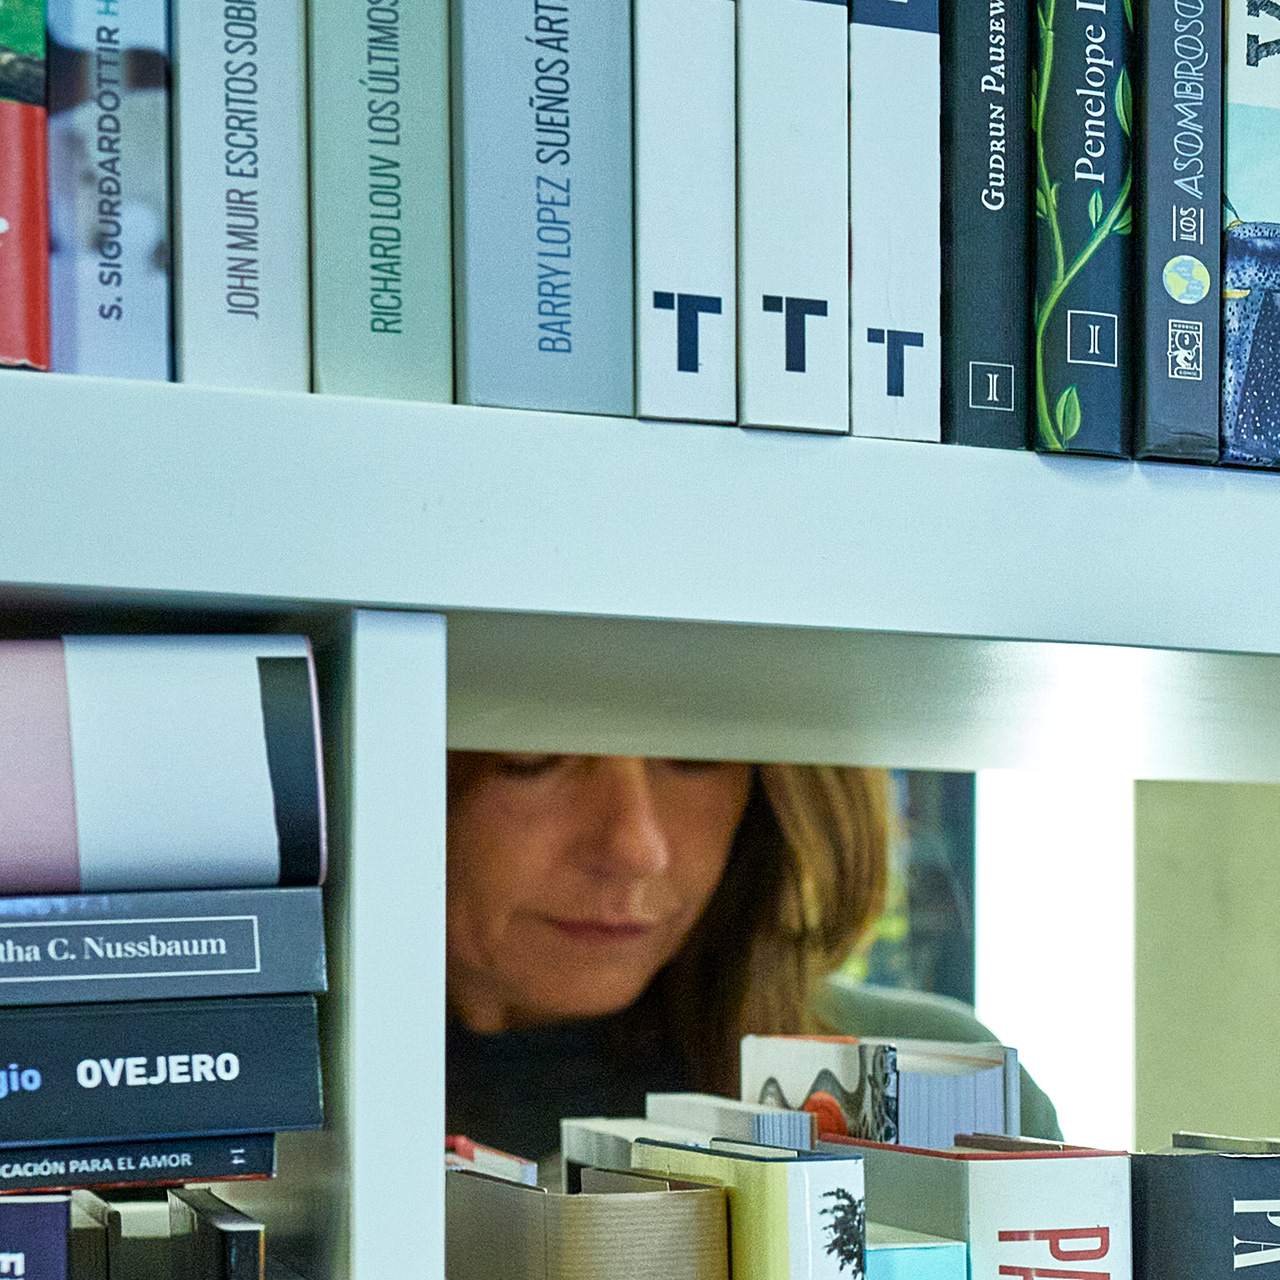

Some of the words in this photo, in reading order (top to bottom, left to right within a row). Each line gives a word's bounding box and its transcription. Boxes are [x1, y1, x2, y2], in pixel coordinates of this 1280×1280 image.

[224, 61, 258, 178] ESCRITOS
[368, 100, 400, 146] LOS
[529, 58, 570, 165] SUEÑOS
[1075, 25, 1113, 183] Penelope
[226, 189, 259, 251] MUIR
[369, 155, 401, 220] LOUV
[536, 176, 571, 258] LOPEZ
[227, 257, 259, 319] JOHN
[370, 226, 402, 334] RICHARD
[537, 263, 572, 353] BARRY
[84, 935, 226, 959] Nussbaum
[77, 1053, 239, 1088] OVEJERO
